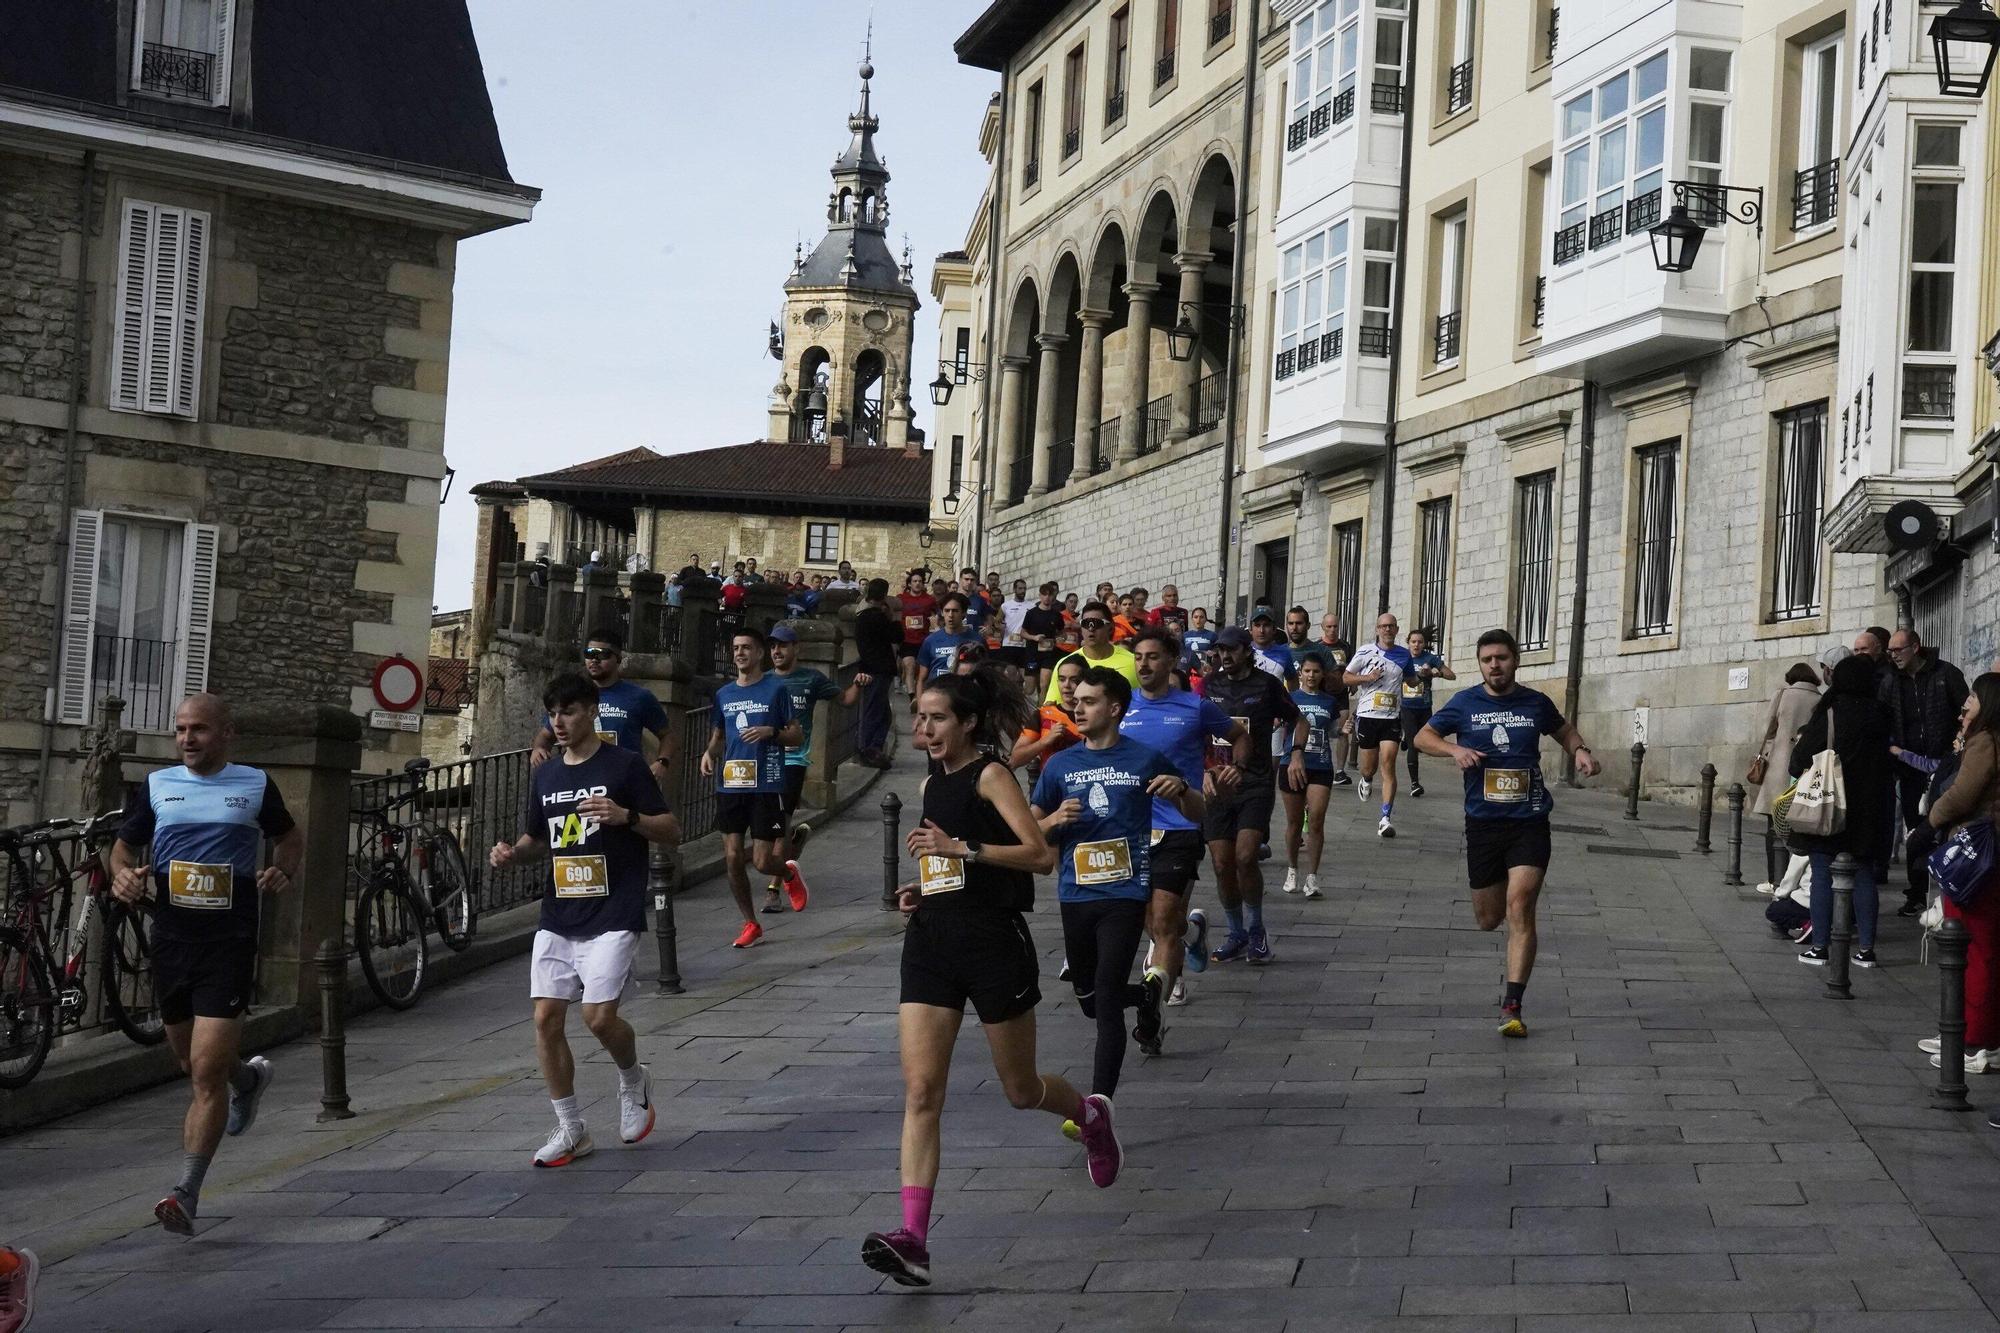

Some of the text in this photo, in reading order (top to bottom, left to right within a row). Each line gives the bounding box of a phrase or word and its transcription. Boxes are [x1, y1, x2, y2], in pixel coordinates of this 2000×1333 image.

[1478, 711, 1514, 719] CONQUISTA
[1480, 715, 1527, 725] ALMENDRA
[1073, 766, 1116, 778] CONQUISTA
[1075, 771, 1131, 785] ALMENDRA
[1104, 779, 1141, 787] KONKISTA
[1496, 777, 1519, 790] 626
[542, 785, 608, 807] HEAD
[547, 812, 601, 849] CAP
[1088, 850, 1115, 868] 405
[566, 866, 593, 882] 690
[186, 873, 215, 892] 270
